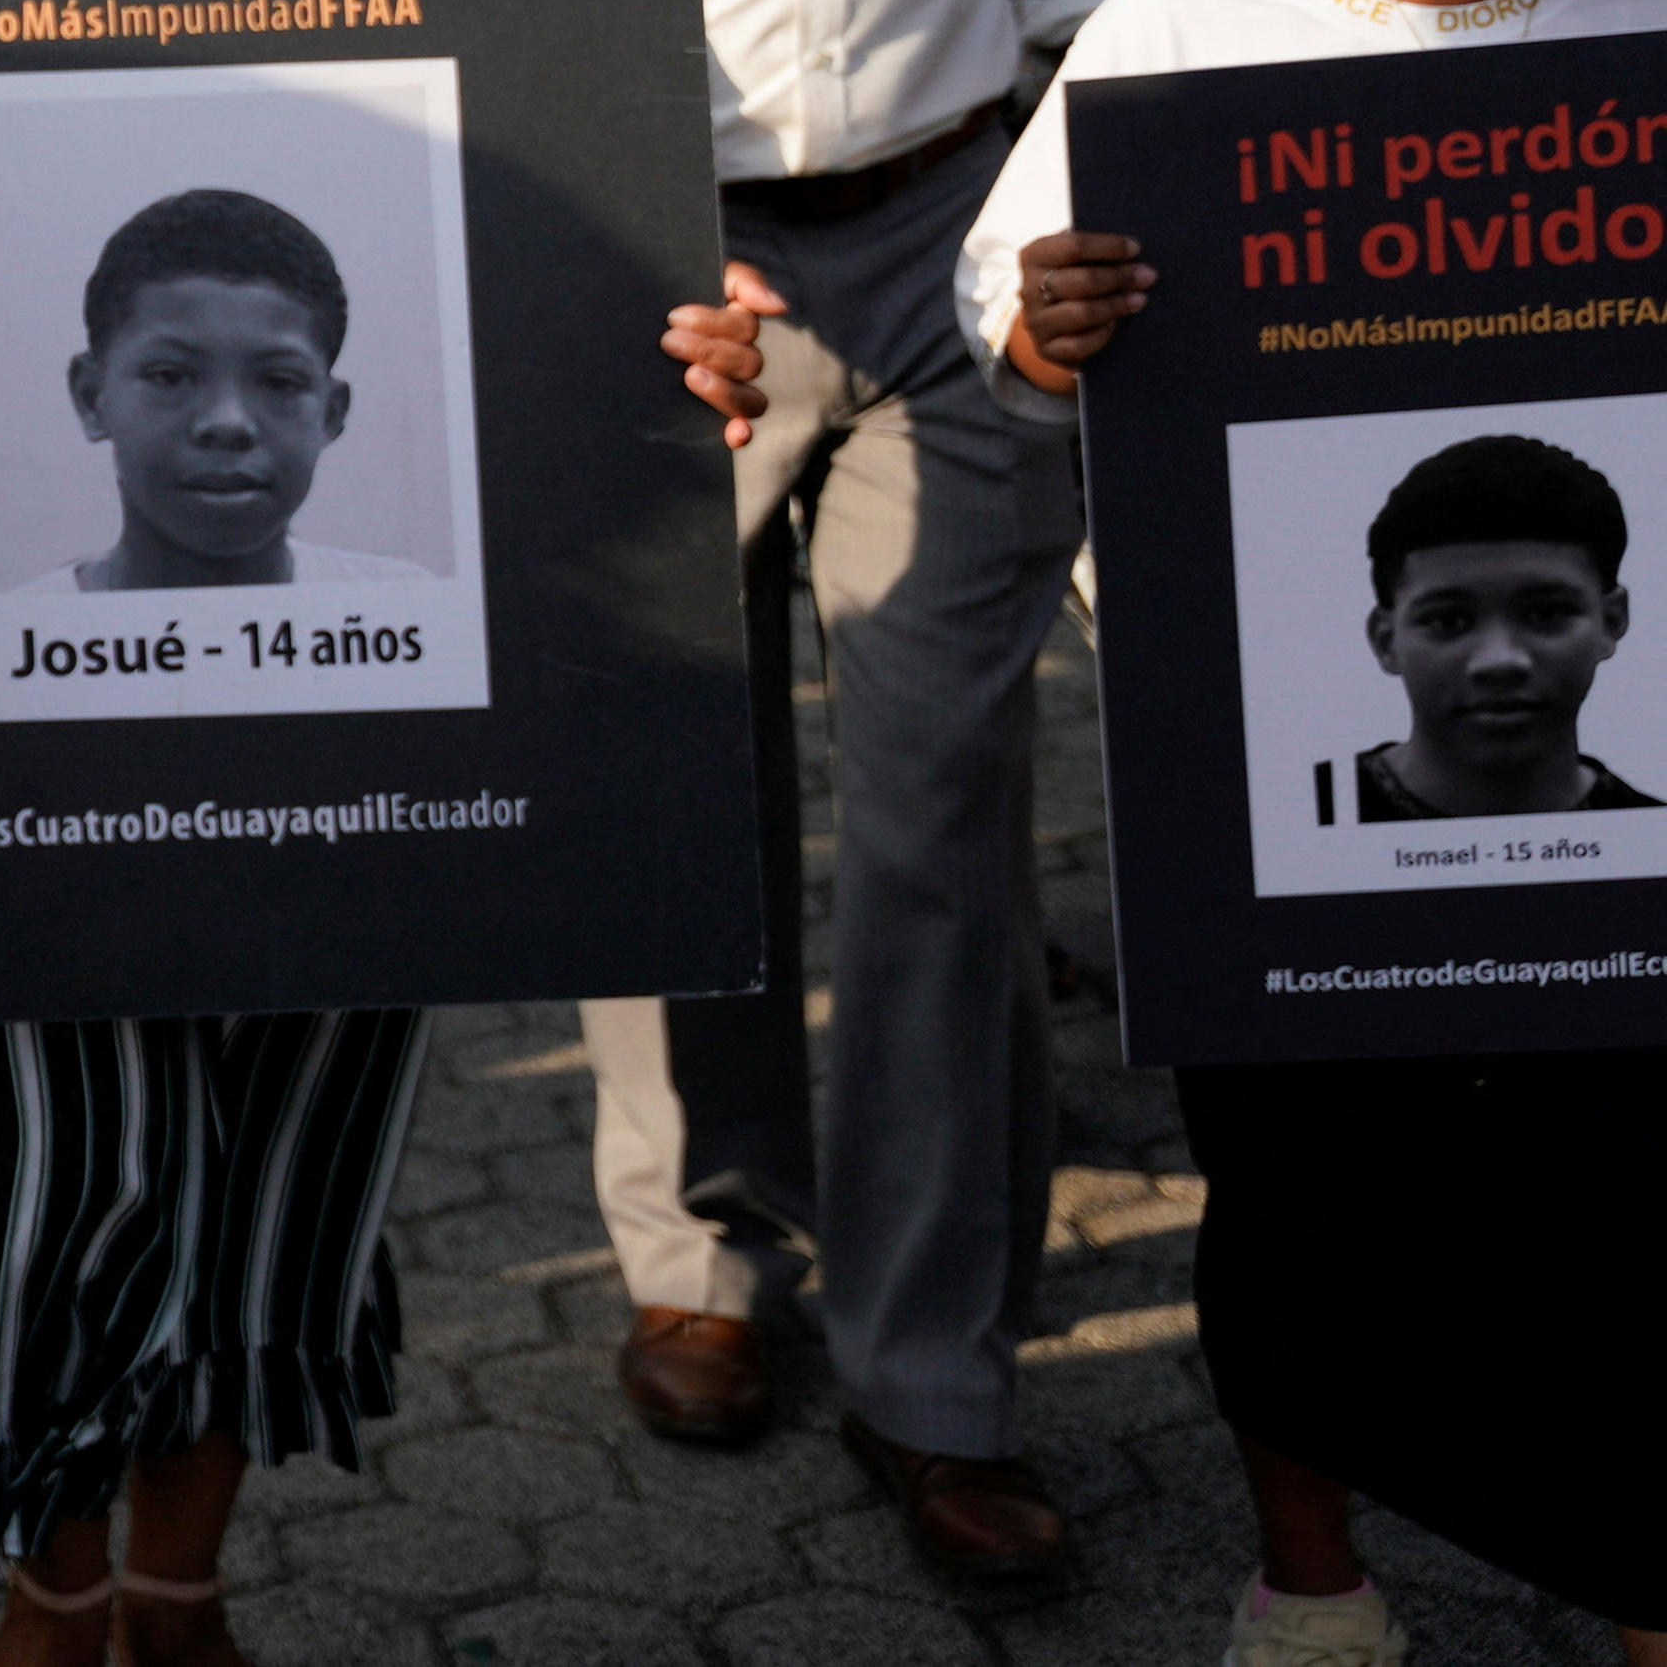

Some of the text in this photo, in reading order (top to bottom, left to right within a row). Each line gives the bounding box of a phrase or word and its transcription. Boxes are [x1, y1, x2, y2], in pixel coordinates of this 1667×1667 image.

[1237, 123, 1355, 203] ¡Ni
[1241, 185, 1665, 289] ni olvido
[1260, 296, 1667, 352] #NoMásImpunidadFFA
[11, 621, 186, 679] Josué
[240, 620, 298, 669] 14
[310, 615, 423, 667] años
[1395, 843, 1478, 868] Ismael
[1503, 841, 1533, 863] 15
[1540, 838, 1602, 861] años
[1266, 950, 1667, 994] #LosCuatrodeGuayaquilEc
